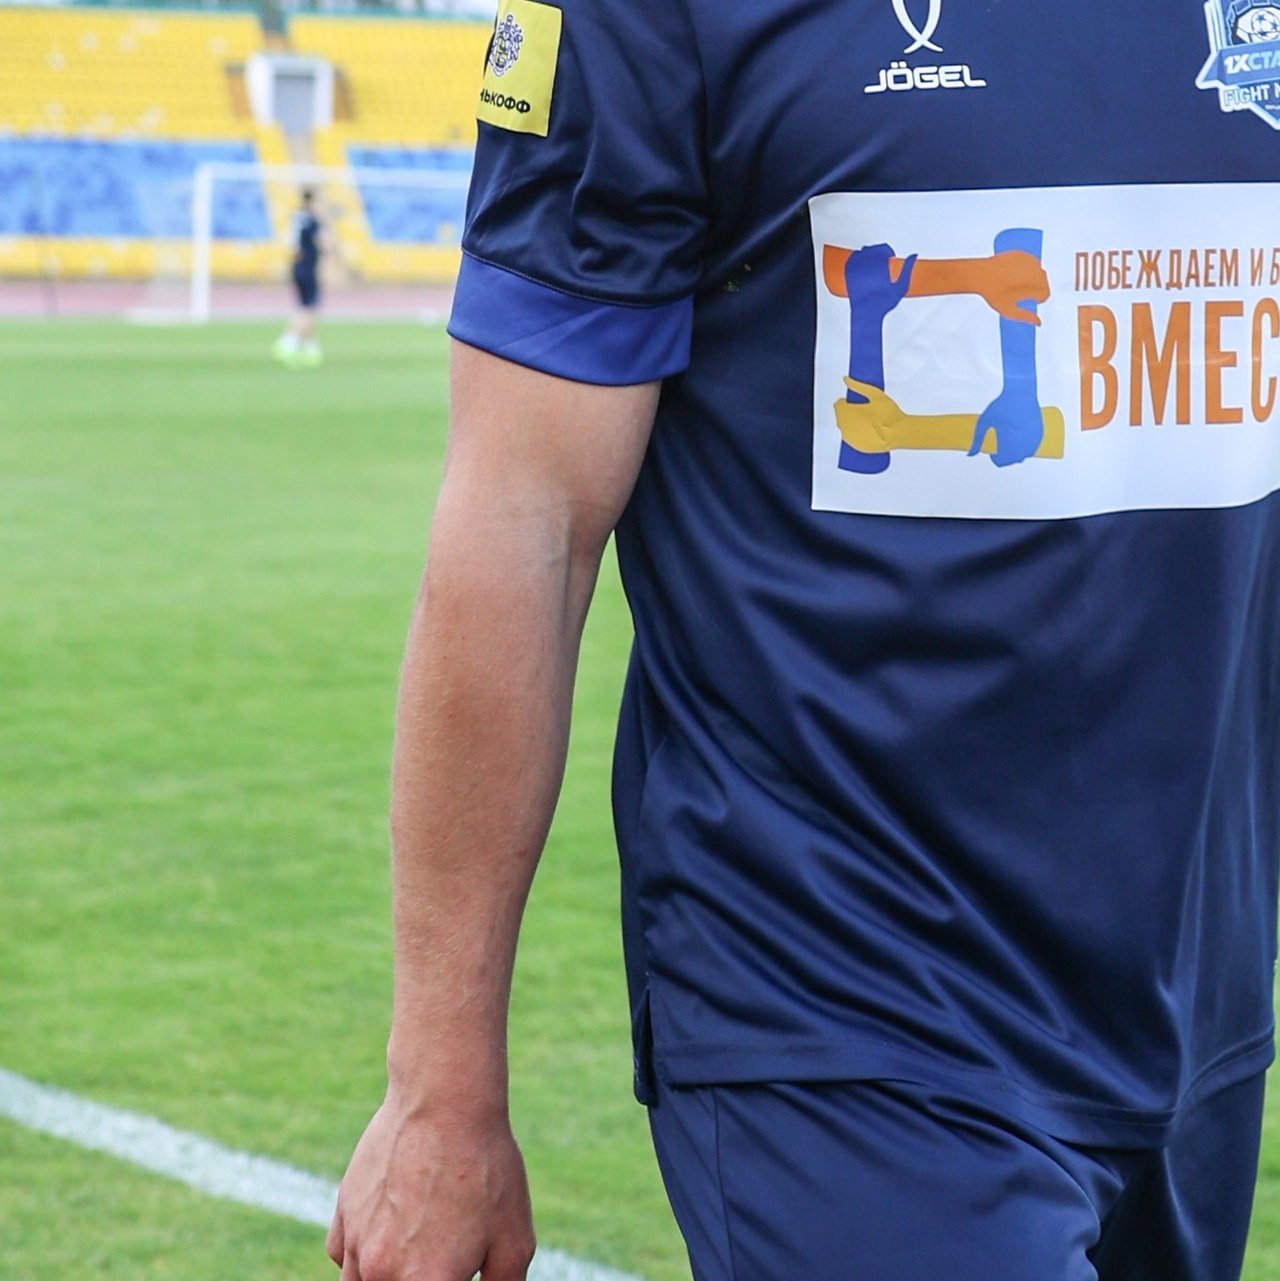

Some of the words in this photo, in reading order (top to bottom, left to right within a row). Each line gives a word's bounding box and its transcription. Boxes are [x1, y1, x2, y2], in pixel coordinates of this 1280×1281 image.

[864, 61, 987, 93] JÖGEL
[1223, 84, 1271, 107] FIGHT
[1074, 248, 1240, 291] ПОБЕЖДАЕМ
[1250, 248, 1263, 287] И
